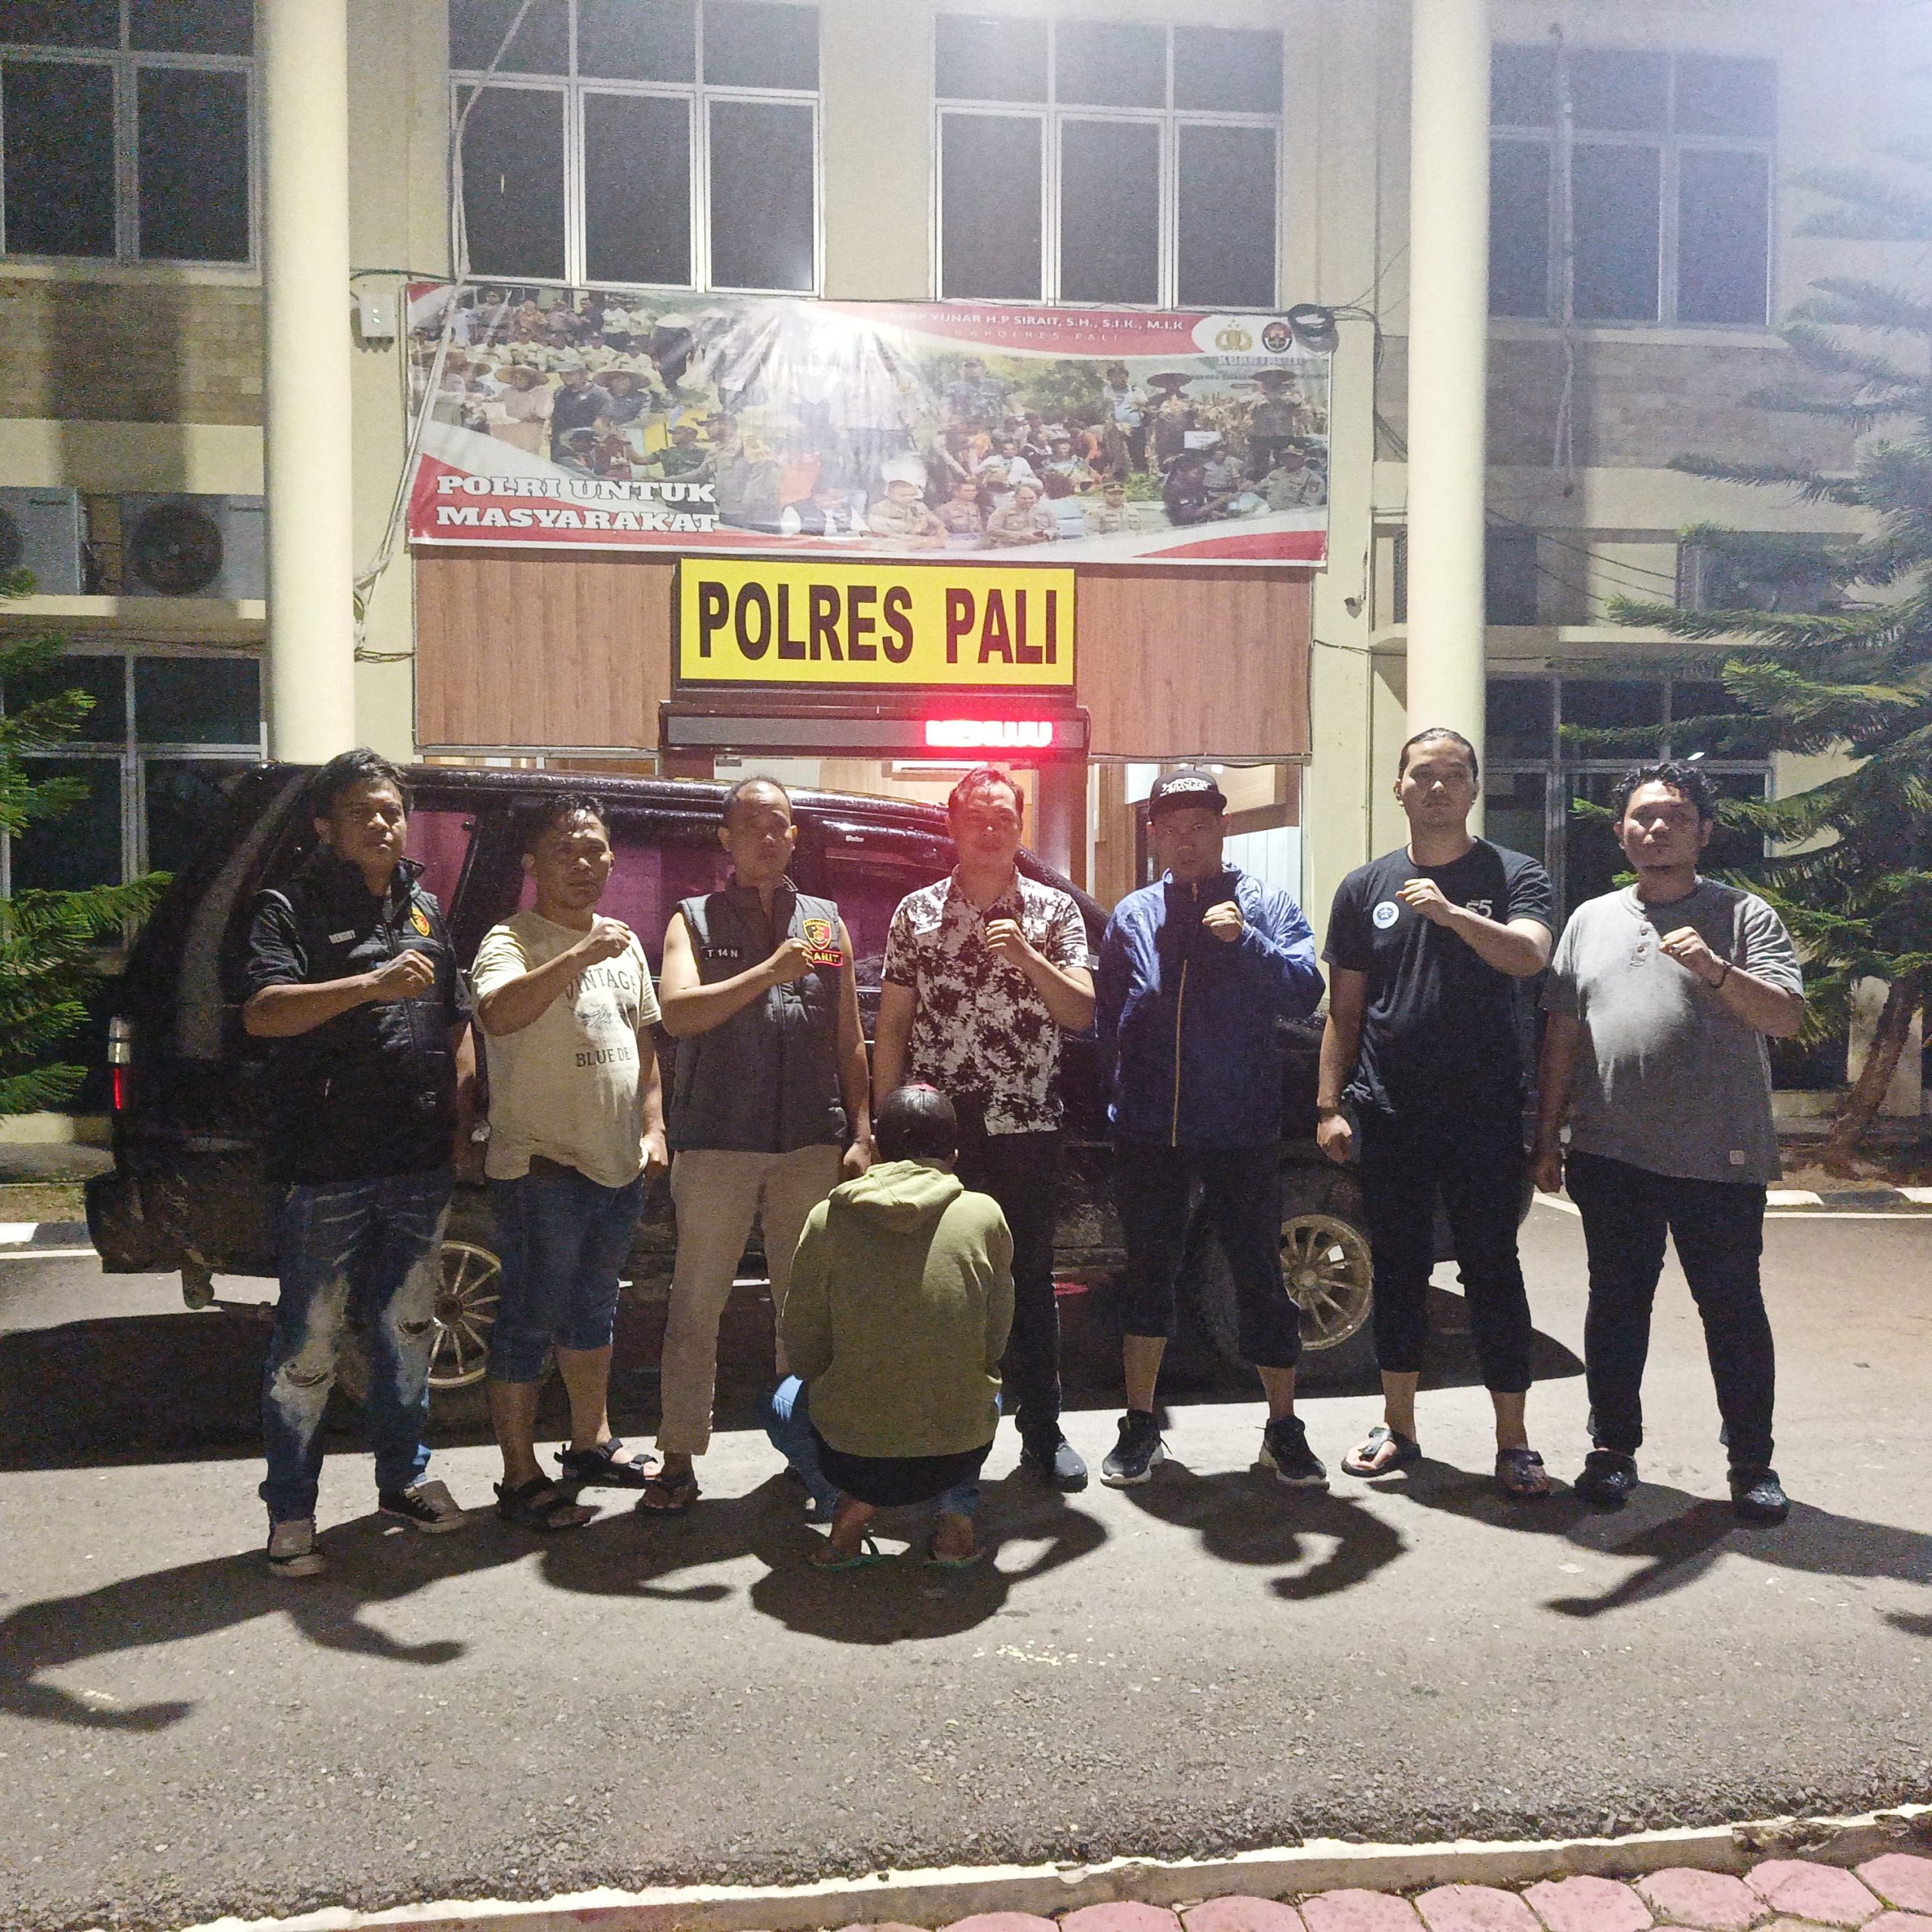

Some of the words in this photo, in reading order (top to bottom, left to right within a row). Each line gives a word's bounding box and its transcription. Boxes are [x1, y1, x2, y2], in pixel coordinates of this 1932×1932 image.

[986, 314, 1010, 324] H.P
[436, 475, 561, 500] POLRI
[570, 479, 717, 503] UNTUK
[436, 506, 720, 533] MASYARAKAT
[698, 580, 914, 664] POLRES
[945, 587, 1057, 665] PALI
[813, 952, 839, 963] ANIT
[575, 1048, 615, 1067] BLUE
